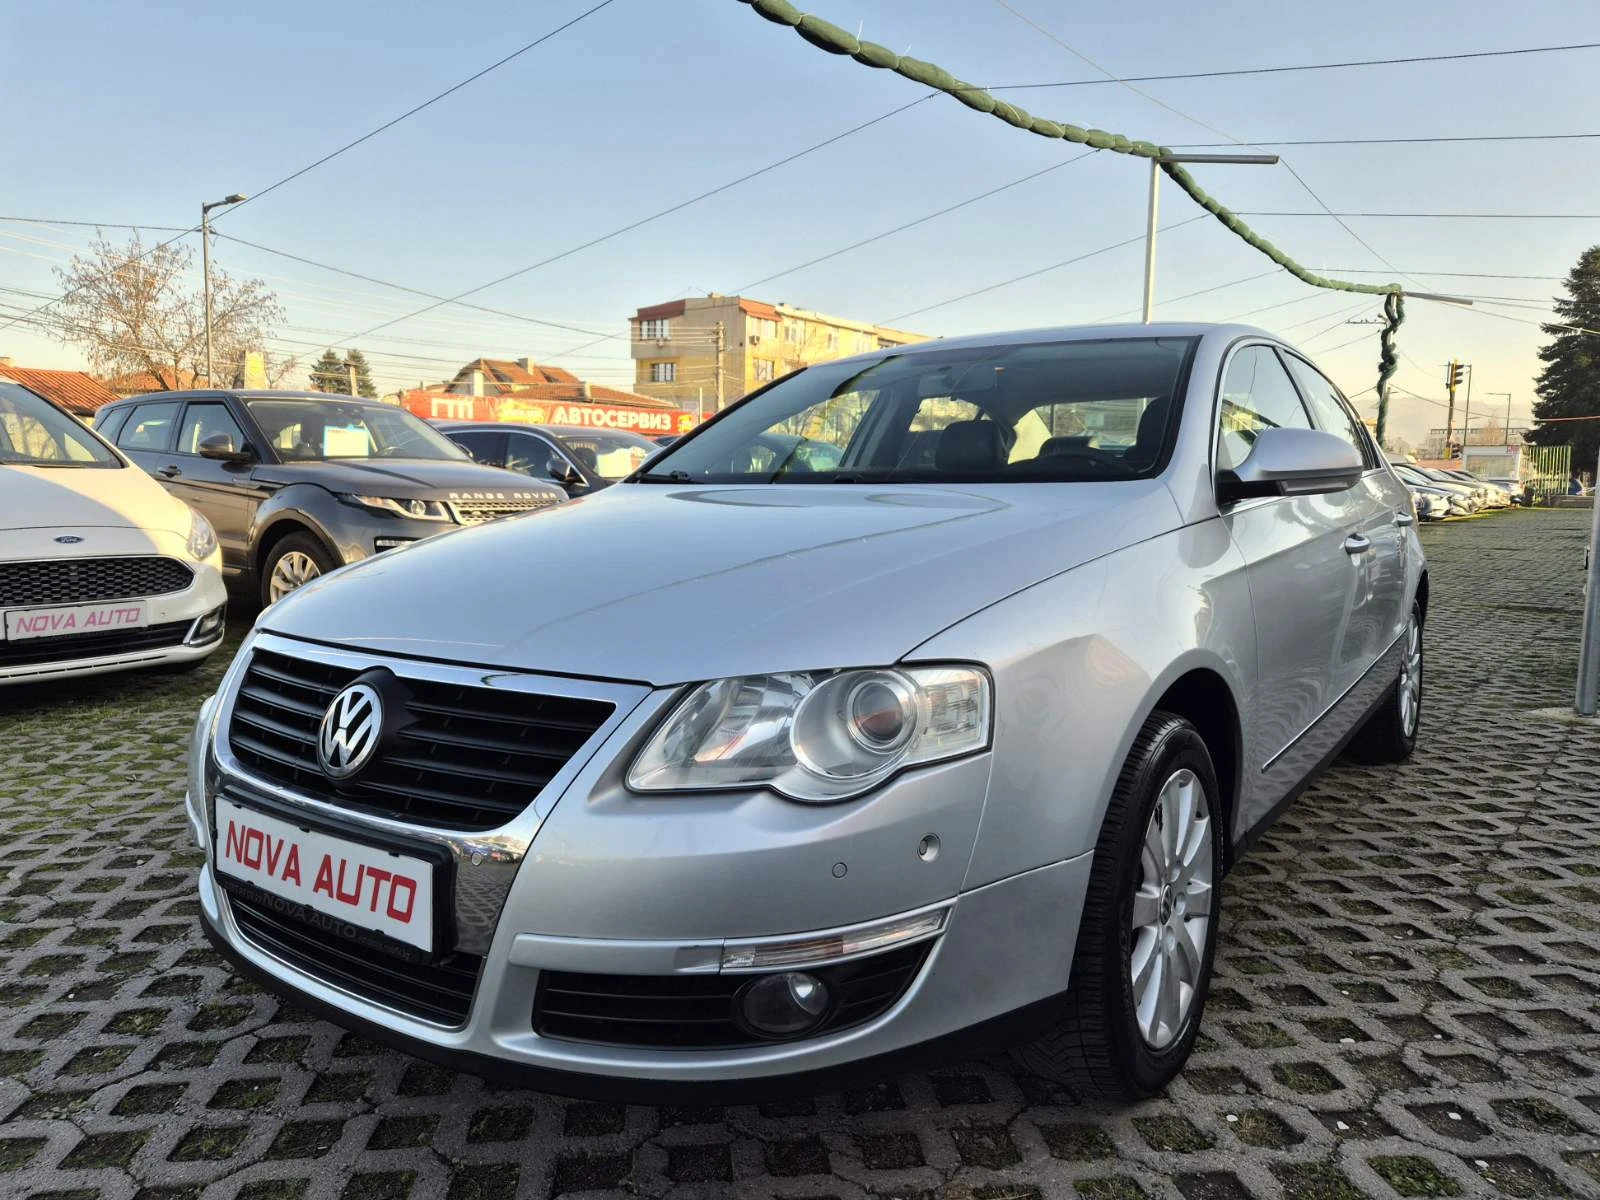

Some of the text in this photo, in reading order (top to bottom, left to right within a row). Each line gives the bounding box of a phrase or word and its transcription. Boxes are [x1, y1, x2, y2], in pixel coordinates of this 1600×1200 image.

[431, 397, 475, 420] ГТП
[553, 405, 672, 430] АВТОСЕРВИЗ
[448, 491, 558, 500] RANGE ROVER
[16, 607, 141, 634] NOVA AUTO
[225, 819, 417, 924] NOVA AUTO
[263, 892, 306, 921] NOVA
[309, 912, 357, 938] AUTO
